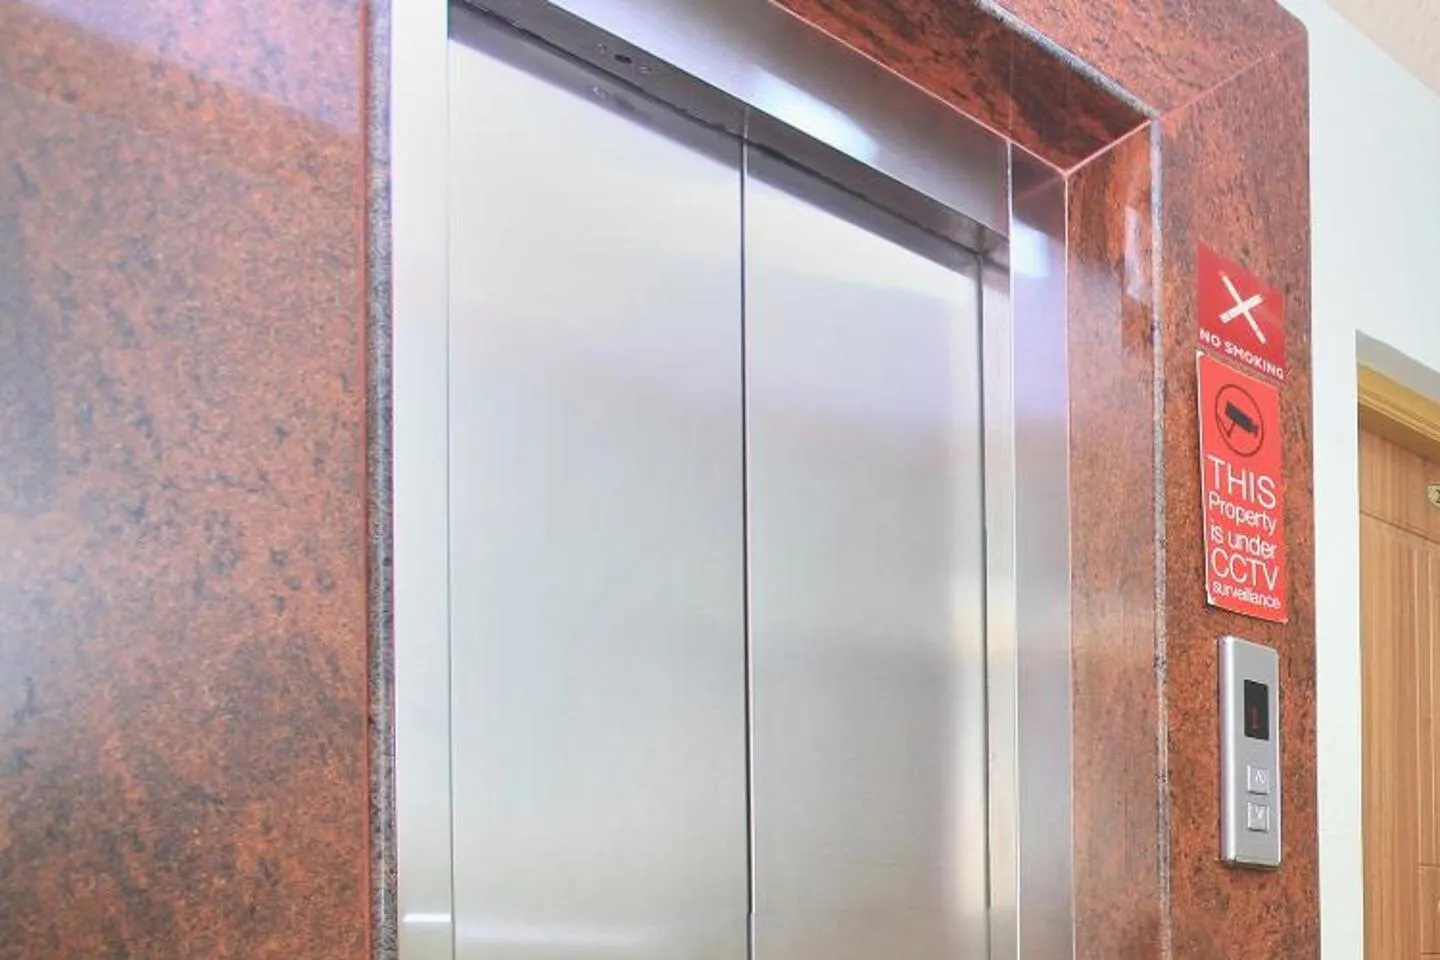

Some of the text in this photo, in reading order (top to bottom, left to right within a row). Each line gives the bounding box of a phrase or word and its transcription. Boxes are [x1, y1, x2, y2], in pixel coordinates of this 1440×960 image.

[1200, 327, 1284, 379] NO SMOKING
[1207, 453, 1276, 509] THIS
[1209, 491, 1276, 536] Property
[1210, 520, 1277, 559] is under
[1211, 547, 1279, 591] CCTV
